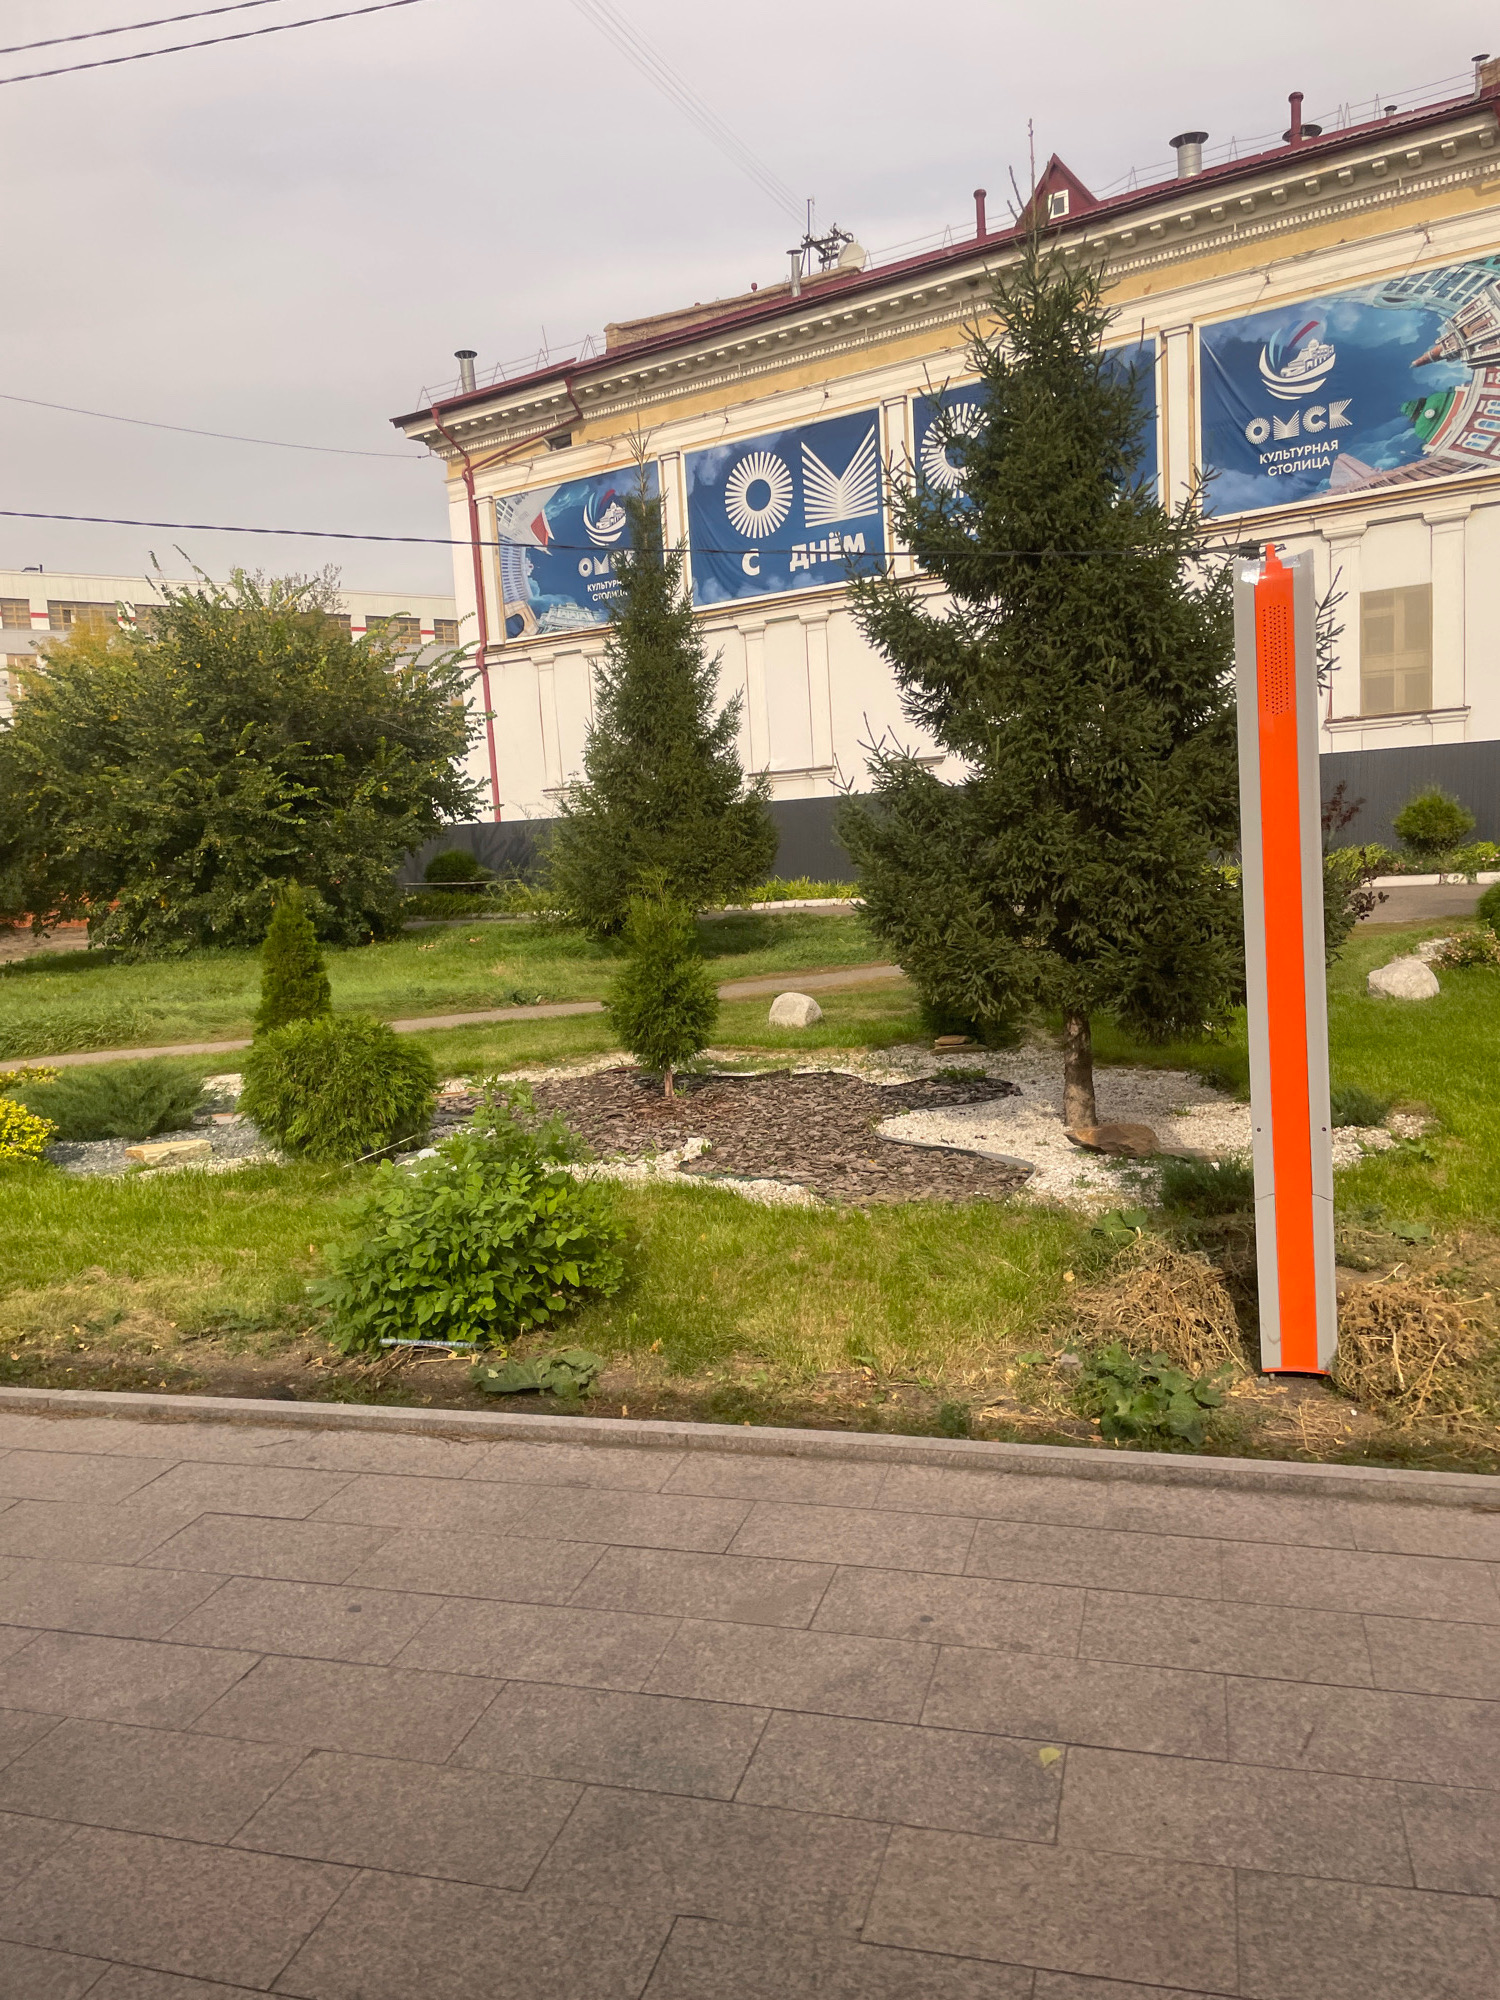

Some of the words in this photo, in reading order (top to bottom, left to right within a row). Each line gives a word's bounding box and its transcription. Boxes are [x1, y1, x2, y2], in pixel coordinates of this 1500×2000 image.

[1245, 398, 1353, 445] ОМСК
[1259, 439, 1339, 465] КУЛЬТУРНАЯ
[1267, 456, 1331, 477] СТОЛИЦА
[741, 548, 760, 576] С
[790, 531, 866, 572] ДНЁМ
[587, 579, 625, 592] КУЛЬТУРН
